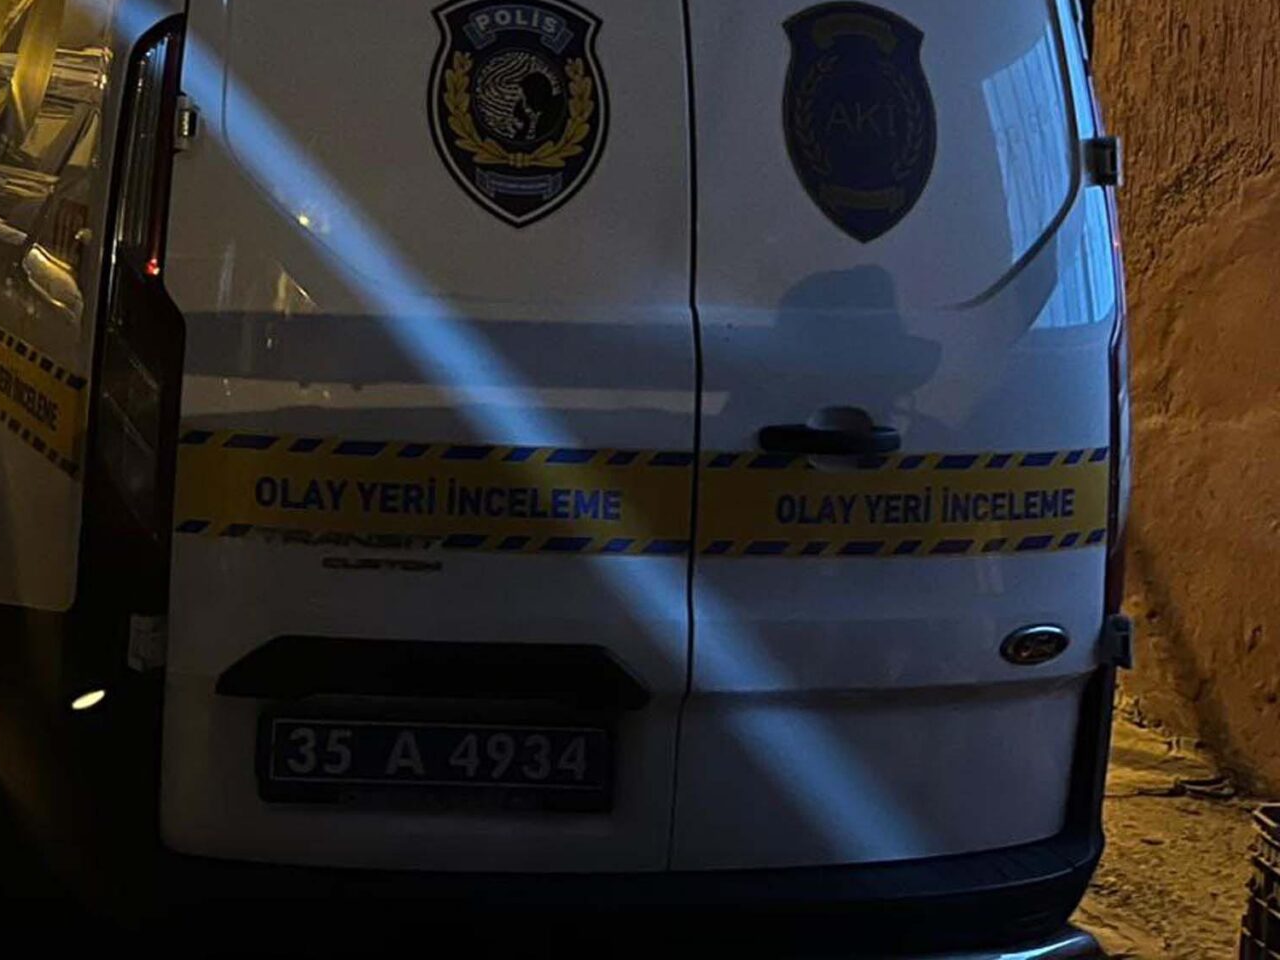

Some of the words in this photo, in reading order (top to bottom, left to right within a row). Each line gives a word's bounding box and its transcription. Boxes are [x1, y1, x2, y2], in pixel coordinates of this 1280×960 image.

[254, 476, 349, 510] OLAY
[776, 493, 858, 524] OLAY
[287, 726, 352, 775] 35
[385, 729, 425, 776] A
[448, 732, 588, 781] 4934
